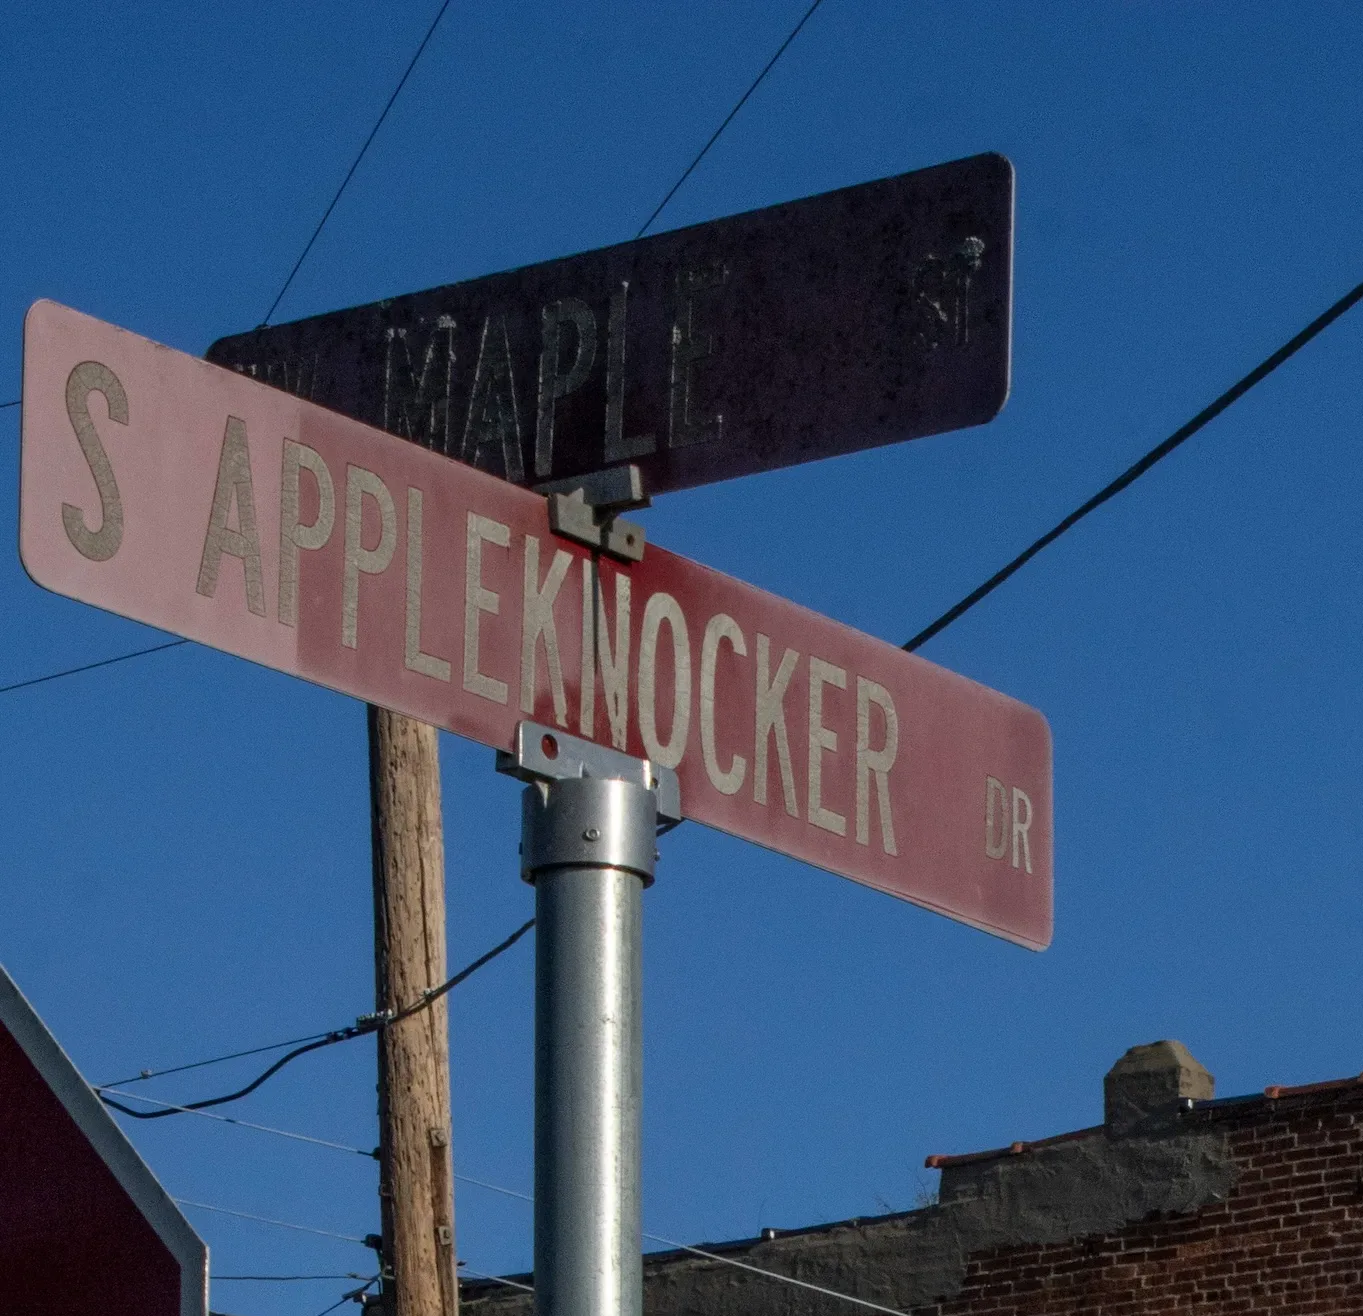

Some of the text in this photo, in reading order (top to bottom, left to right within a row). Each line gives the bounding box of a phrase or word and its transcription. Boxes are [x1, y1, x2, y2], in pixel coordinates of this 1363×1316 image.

[384, 263, 728, 481] MAPLE
[60, 360, 1033, 873] S APPLEKNOCKER DR
